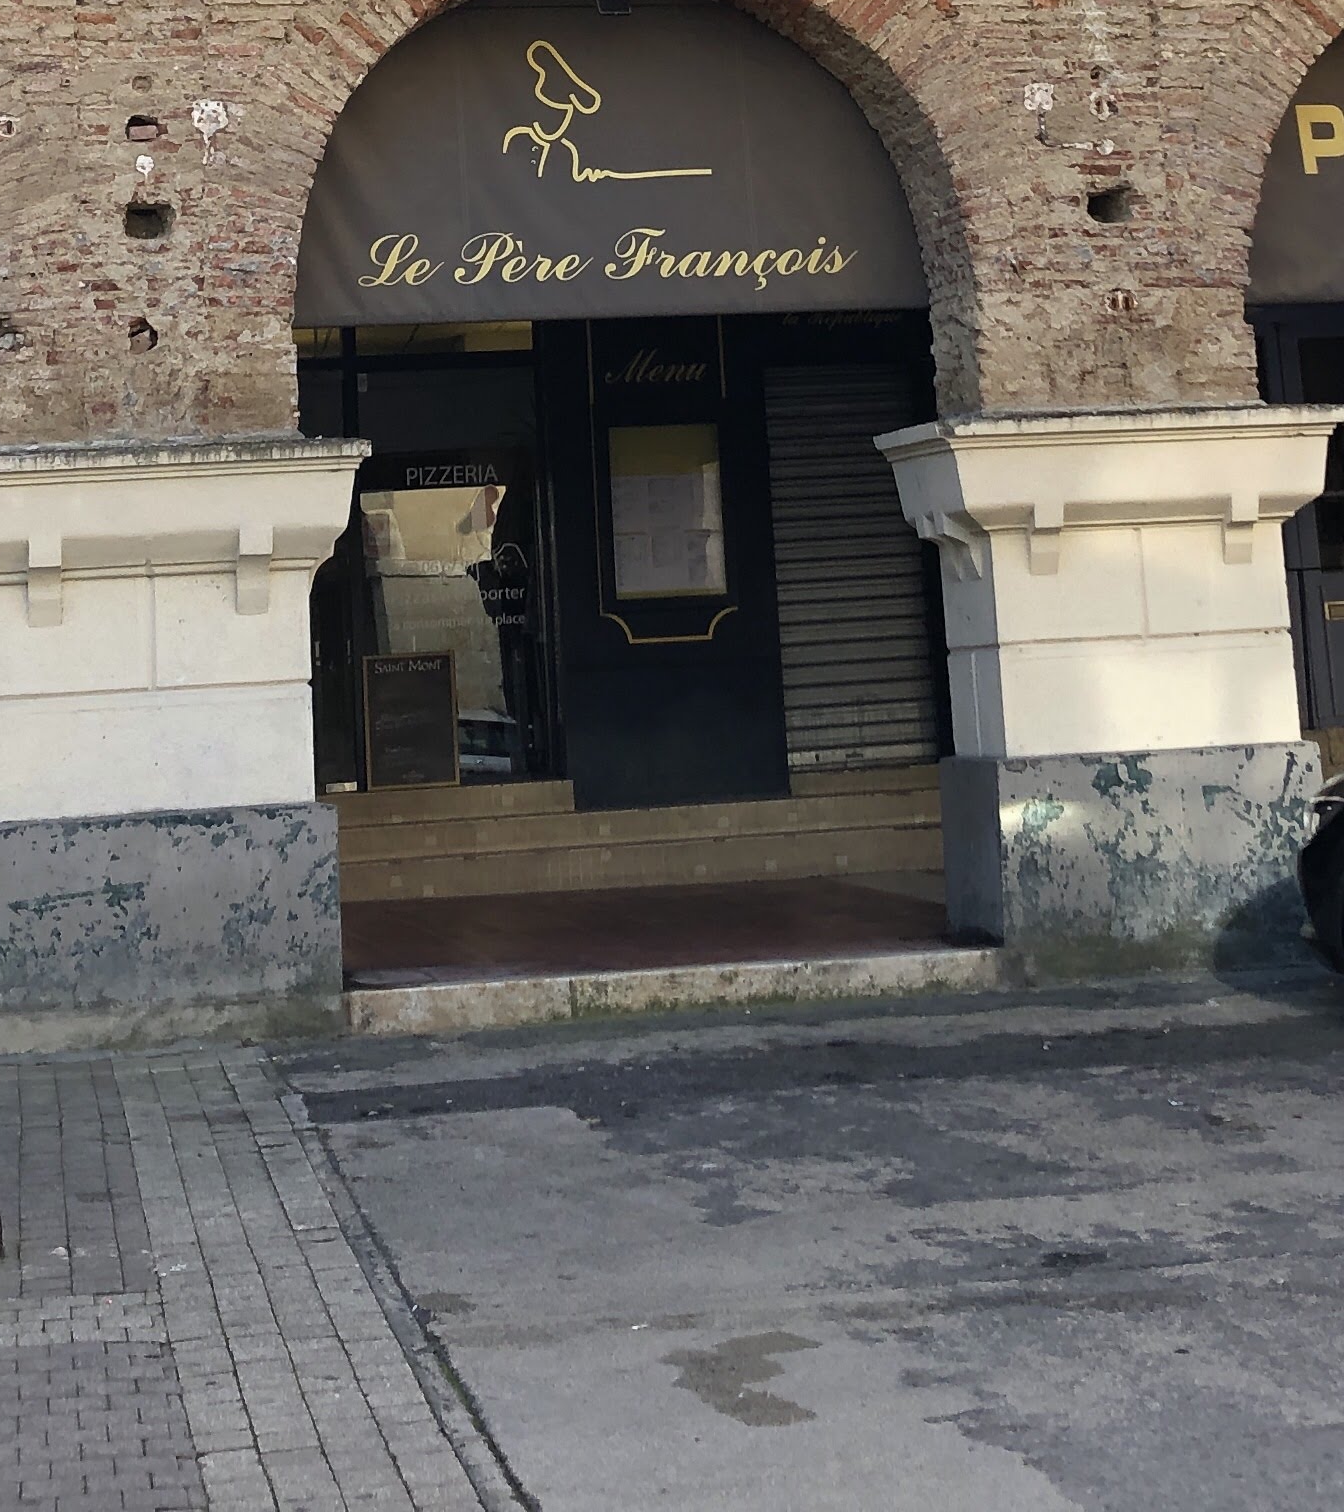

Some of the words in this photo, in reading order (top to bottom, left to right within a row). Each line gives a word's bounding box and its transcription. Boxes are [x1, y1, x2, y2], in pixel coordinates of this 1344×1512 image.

[357, 232, 446, 288] Le
[453, 231, 594, 286] Père
[603, 226, 859, 292] François
[605, 347, 709, 384] Menu
[405, 463, 499, 487] PIZZERIA
[496, 612, 526, 627] place
